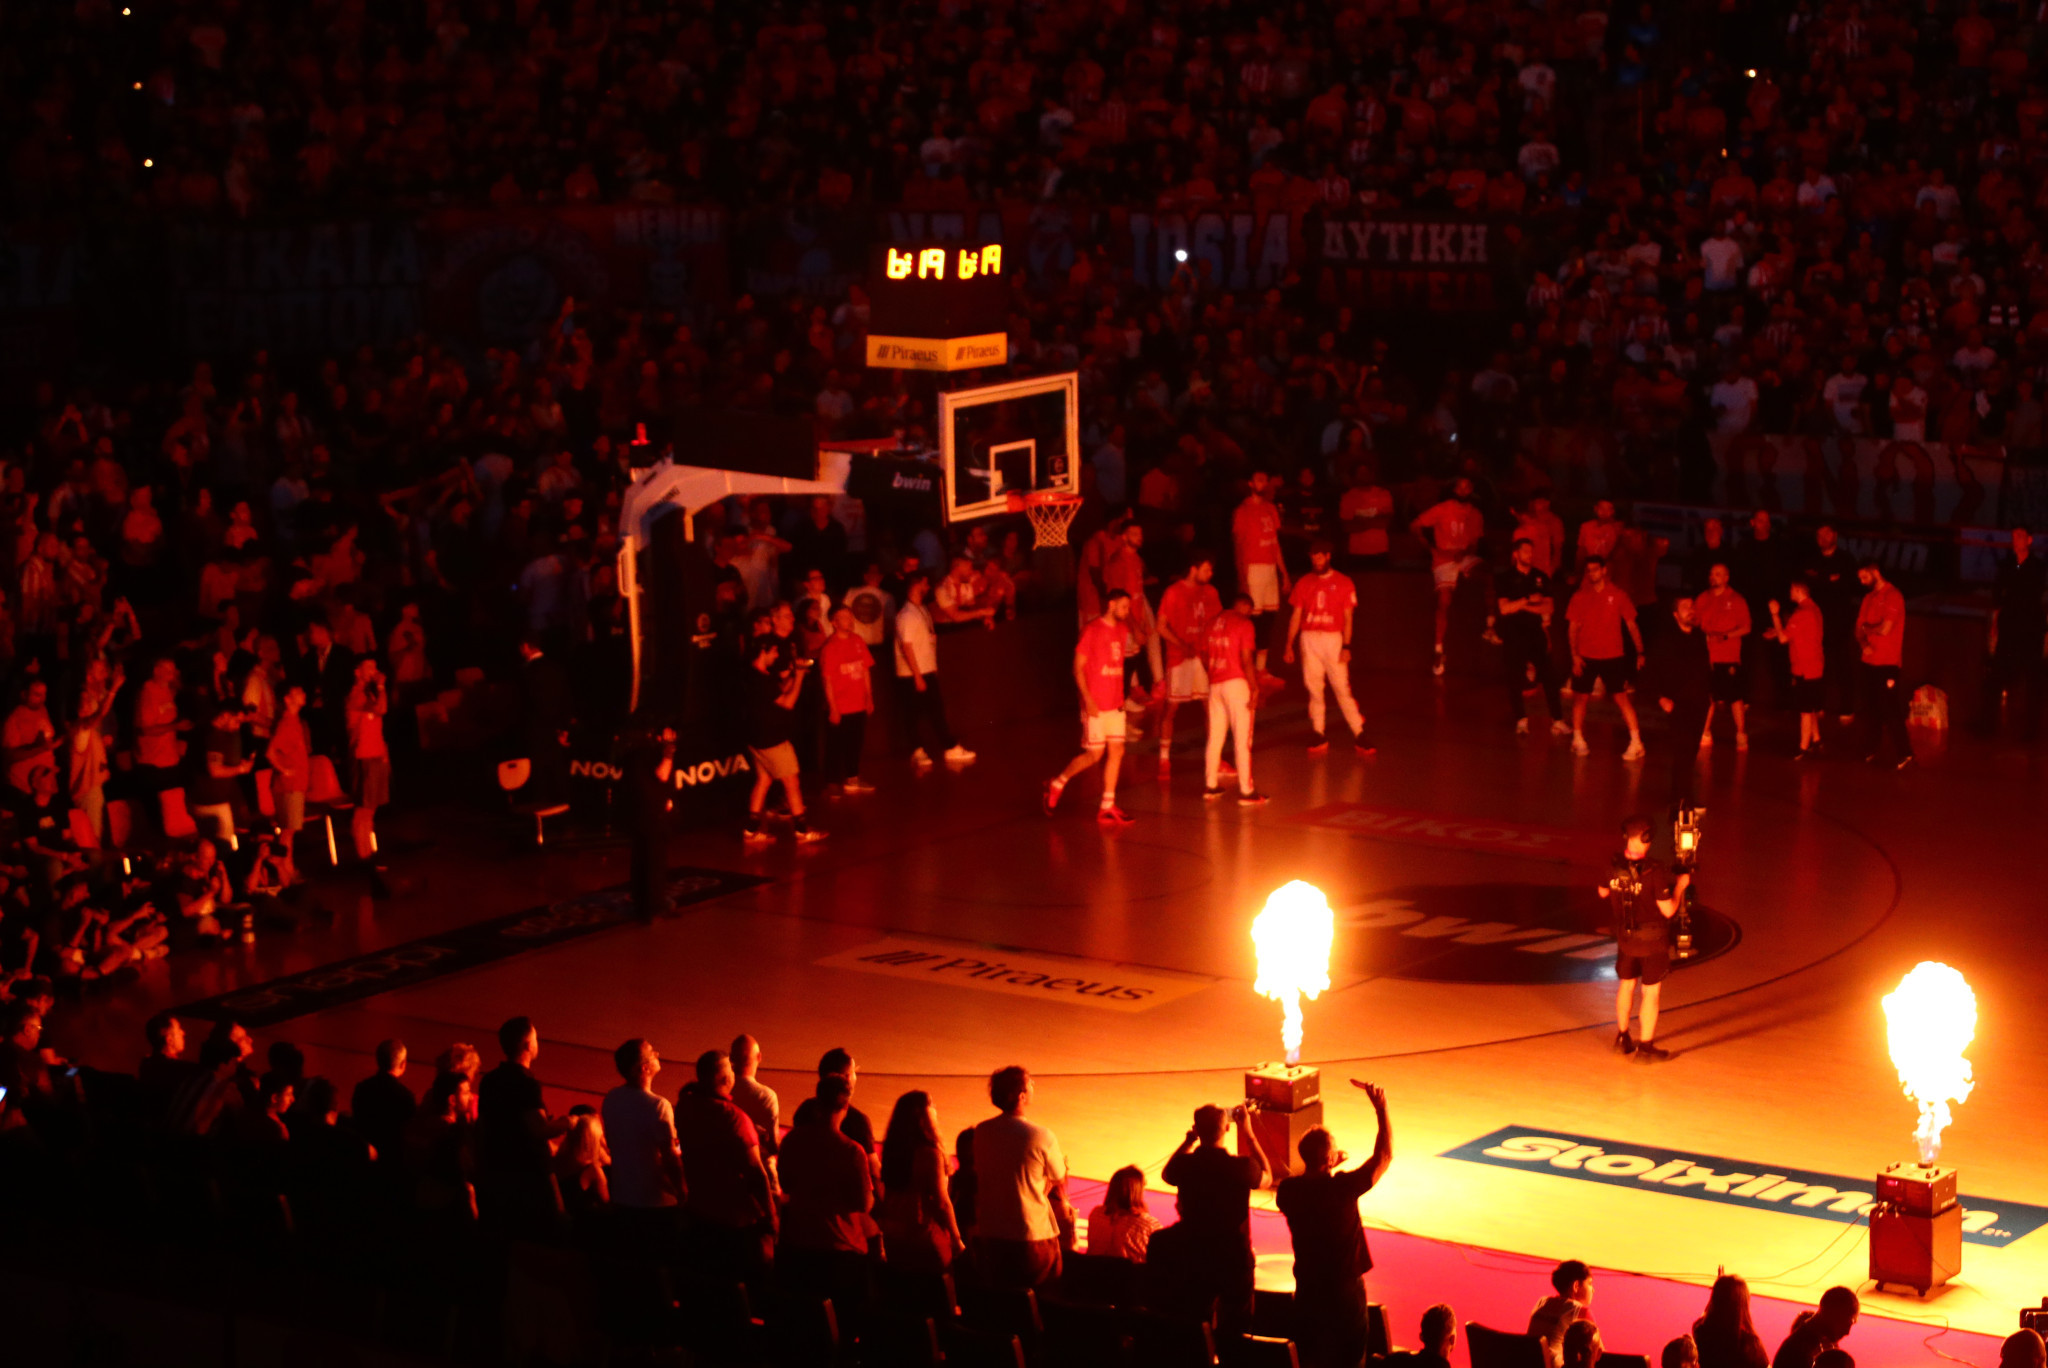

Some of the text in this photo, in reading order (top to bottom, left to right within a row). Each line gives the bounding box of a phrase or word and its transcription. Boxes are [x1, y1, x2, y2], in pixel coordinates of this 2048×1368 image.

[1322, 221, 1488, 262] ΔΥΤΙΚΗ
[891, 344, 939, 361] Piraeus
[892, 472, 932, 491] bwin
[674, 753, 751, 790] NOVA
[929, 957, 1154, 1000] Piraeus
[1482, 1135, 2000, 1234] Stoiximn
